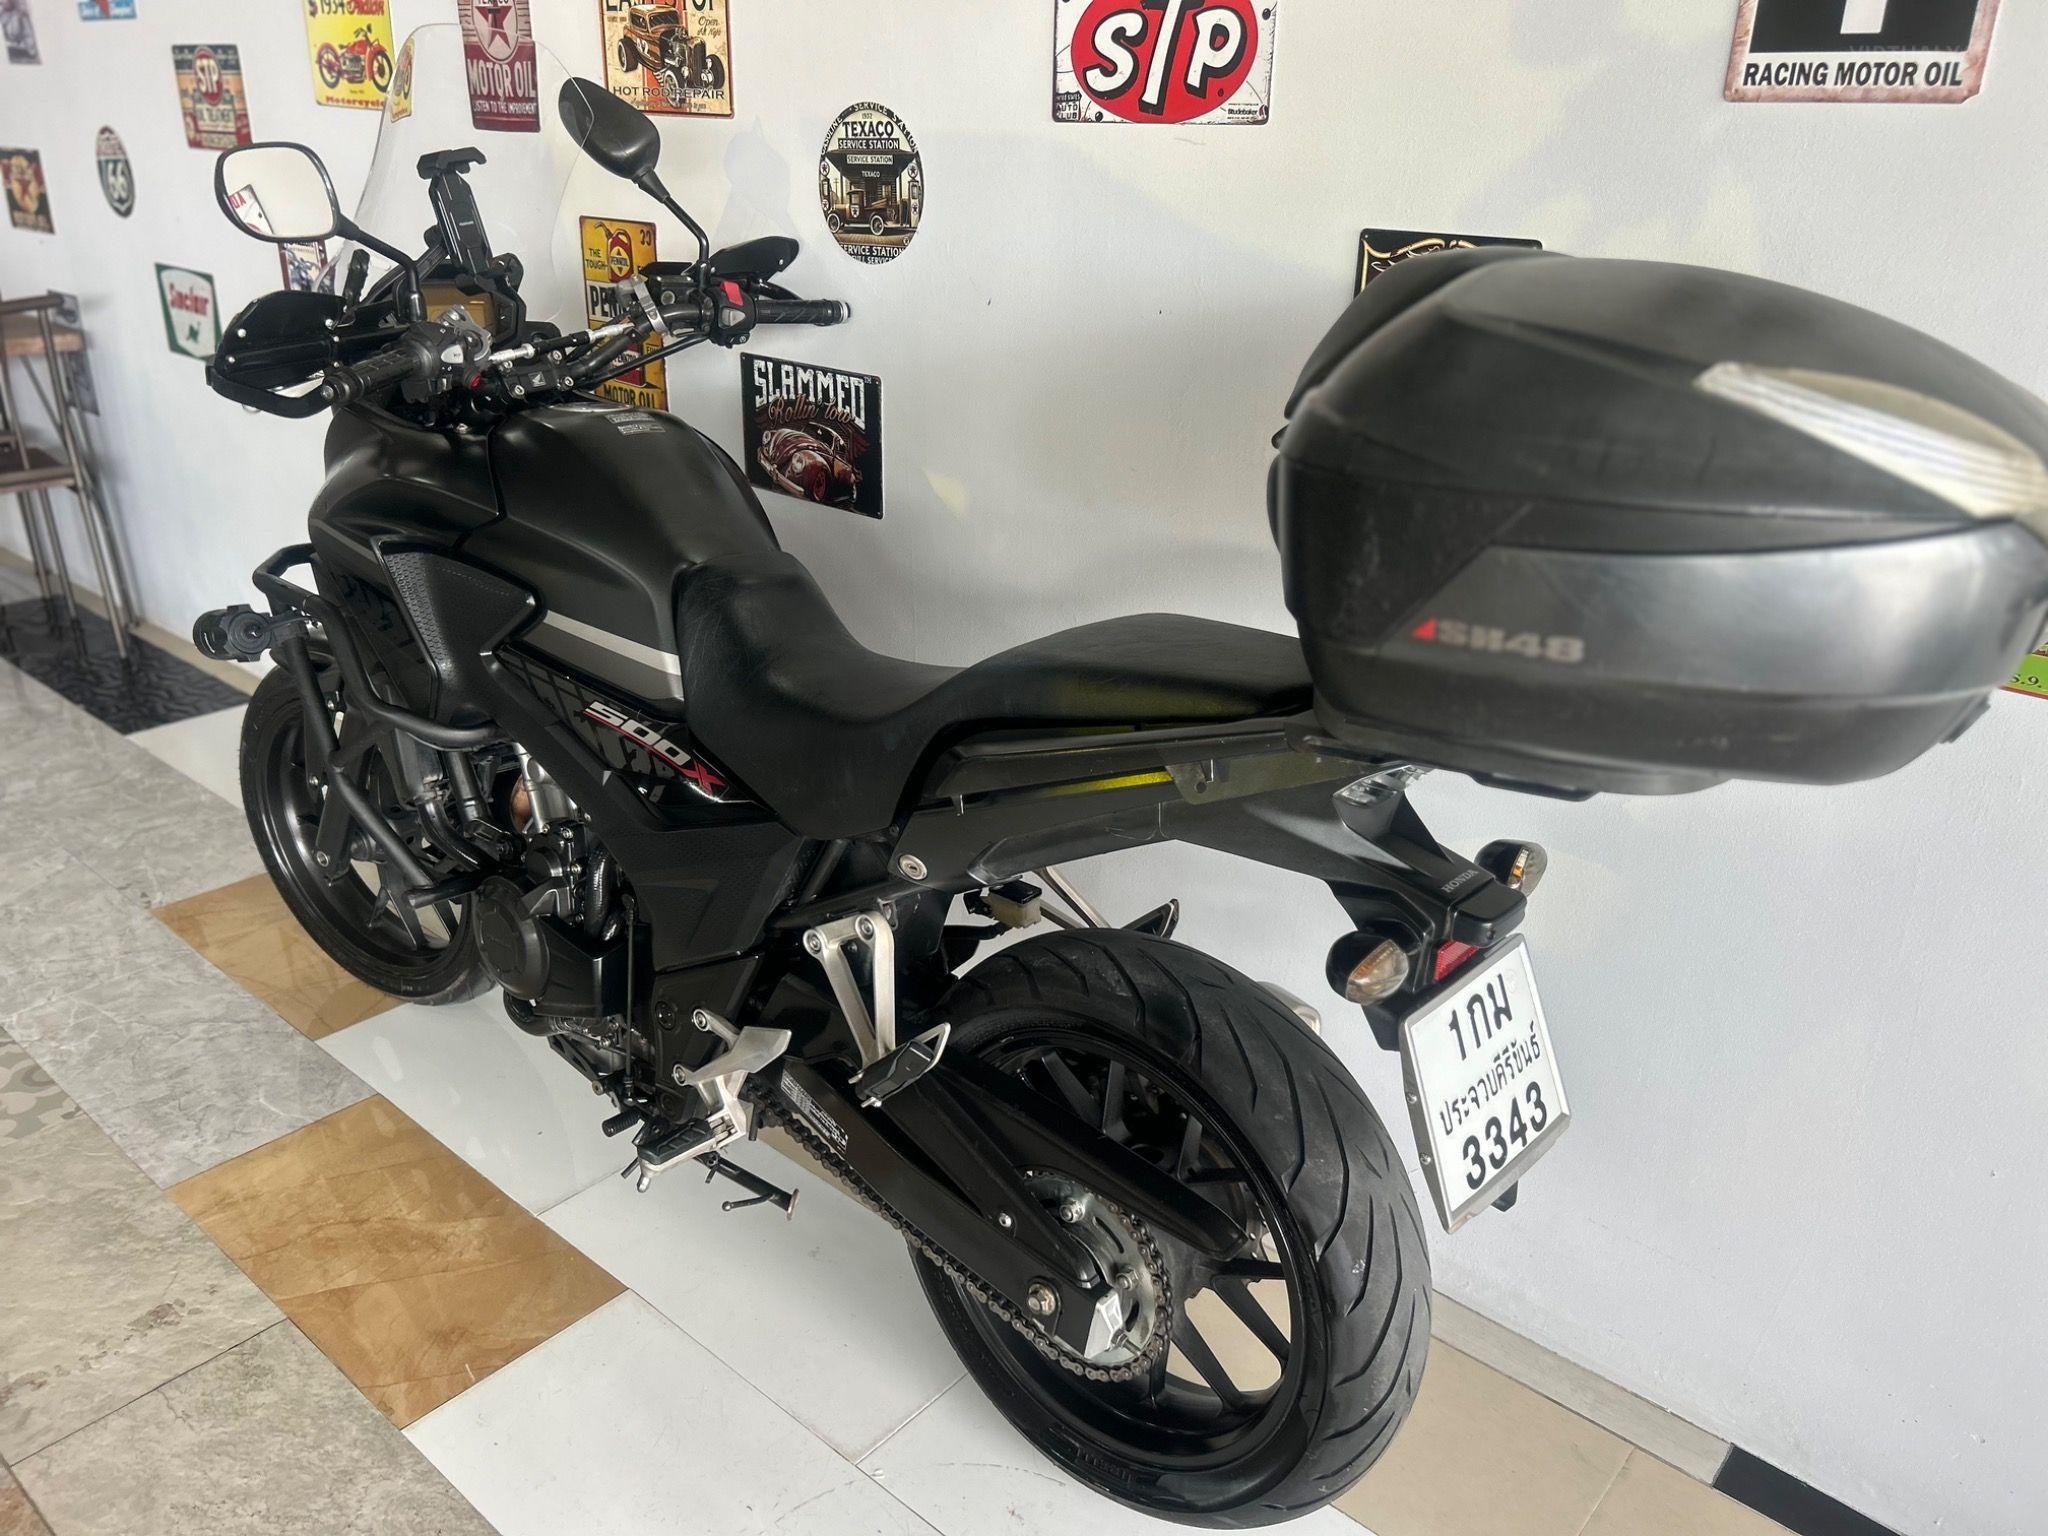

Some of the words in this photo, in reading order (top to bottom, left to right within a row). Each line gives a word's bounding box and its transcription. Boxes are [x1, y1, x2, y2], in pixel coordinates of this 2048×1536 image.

[1082, 0, 1248, 116] STP
[467, 58, 514, 97] MOTOR
[514, 61, 536, 98] OIL
[1742, 61, 1827, 87] RACING
[1834, 61, 1918, 87] MOTOR
[1924, 61, 1963, 87] OIL
[613, 86, 639, 96] HOT
[642, 86, 669, 98] ROD
[674, 87, 725, 100] REPAIR
[490, 101, 498, 113] TO
[498, 101, 508, 114] THE
[854, 101, 889, 115] SERVICE
[1056, 103, 1078, 111] AUTO
[841, 120, 894, 138] TEXACO
[839, 139, 867, 149] SERVICE
[867, 140, 899, 150] STATION
[847, 154, 869, 164] SERVICE
[870, 155, 893, 165] STATION
[107, 161, 129, 200] 66
[861, 170, 881, 178] TEXACO
[588, 247, 601, 258] THE
[603, 383, 636, 406] MOTOR
[753, 358, 866, 431] SLAMMED
[583, 699, 728, 796] 500X
[1440, 868, 1479, 893] HONDA
[1448, 971, 1514, 1061] 1กม
[1439, 1020, 1541, 1136] ประจวบคีรีขันธ์
[1461, 1081, 1548, 1190] 3343
